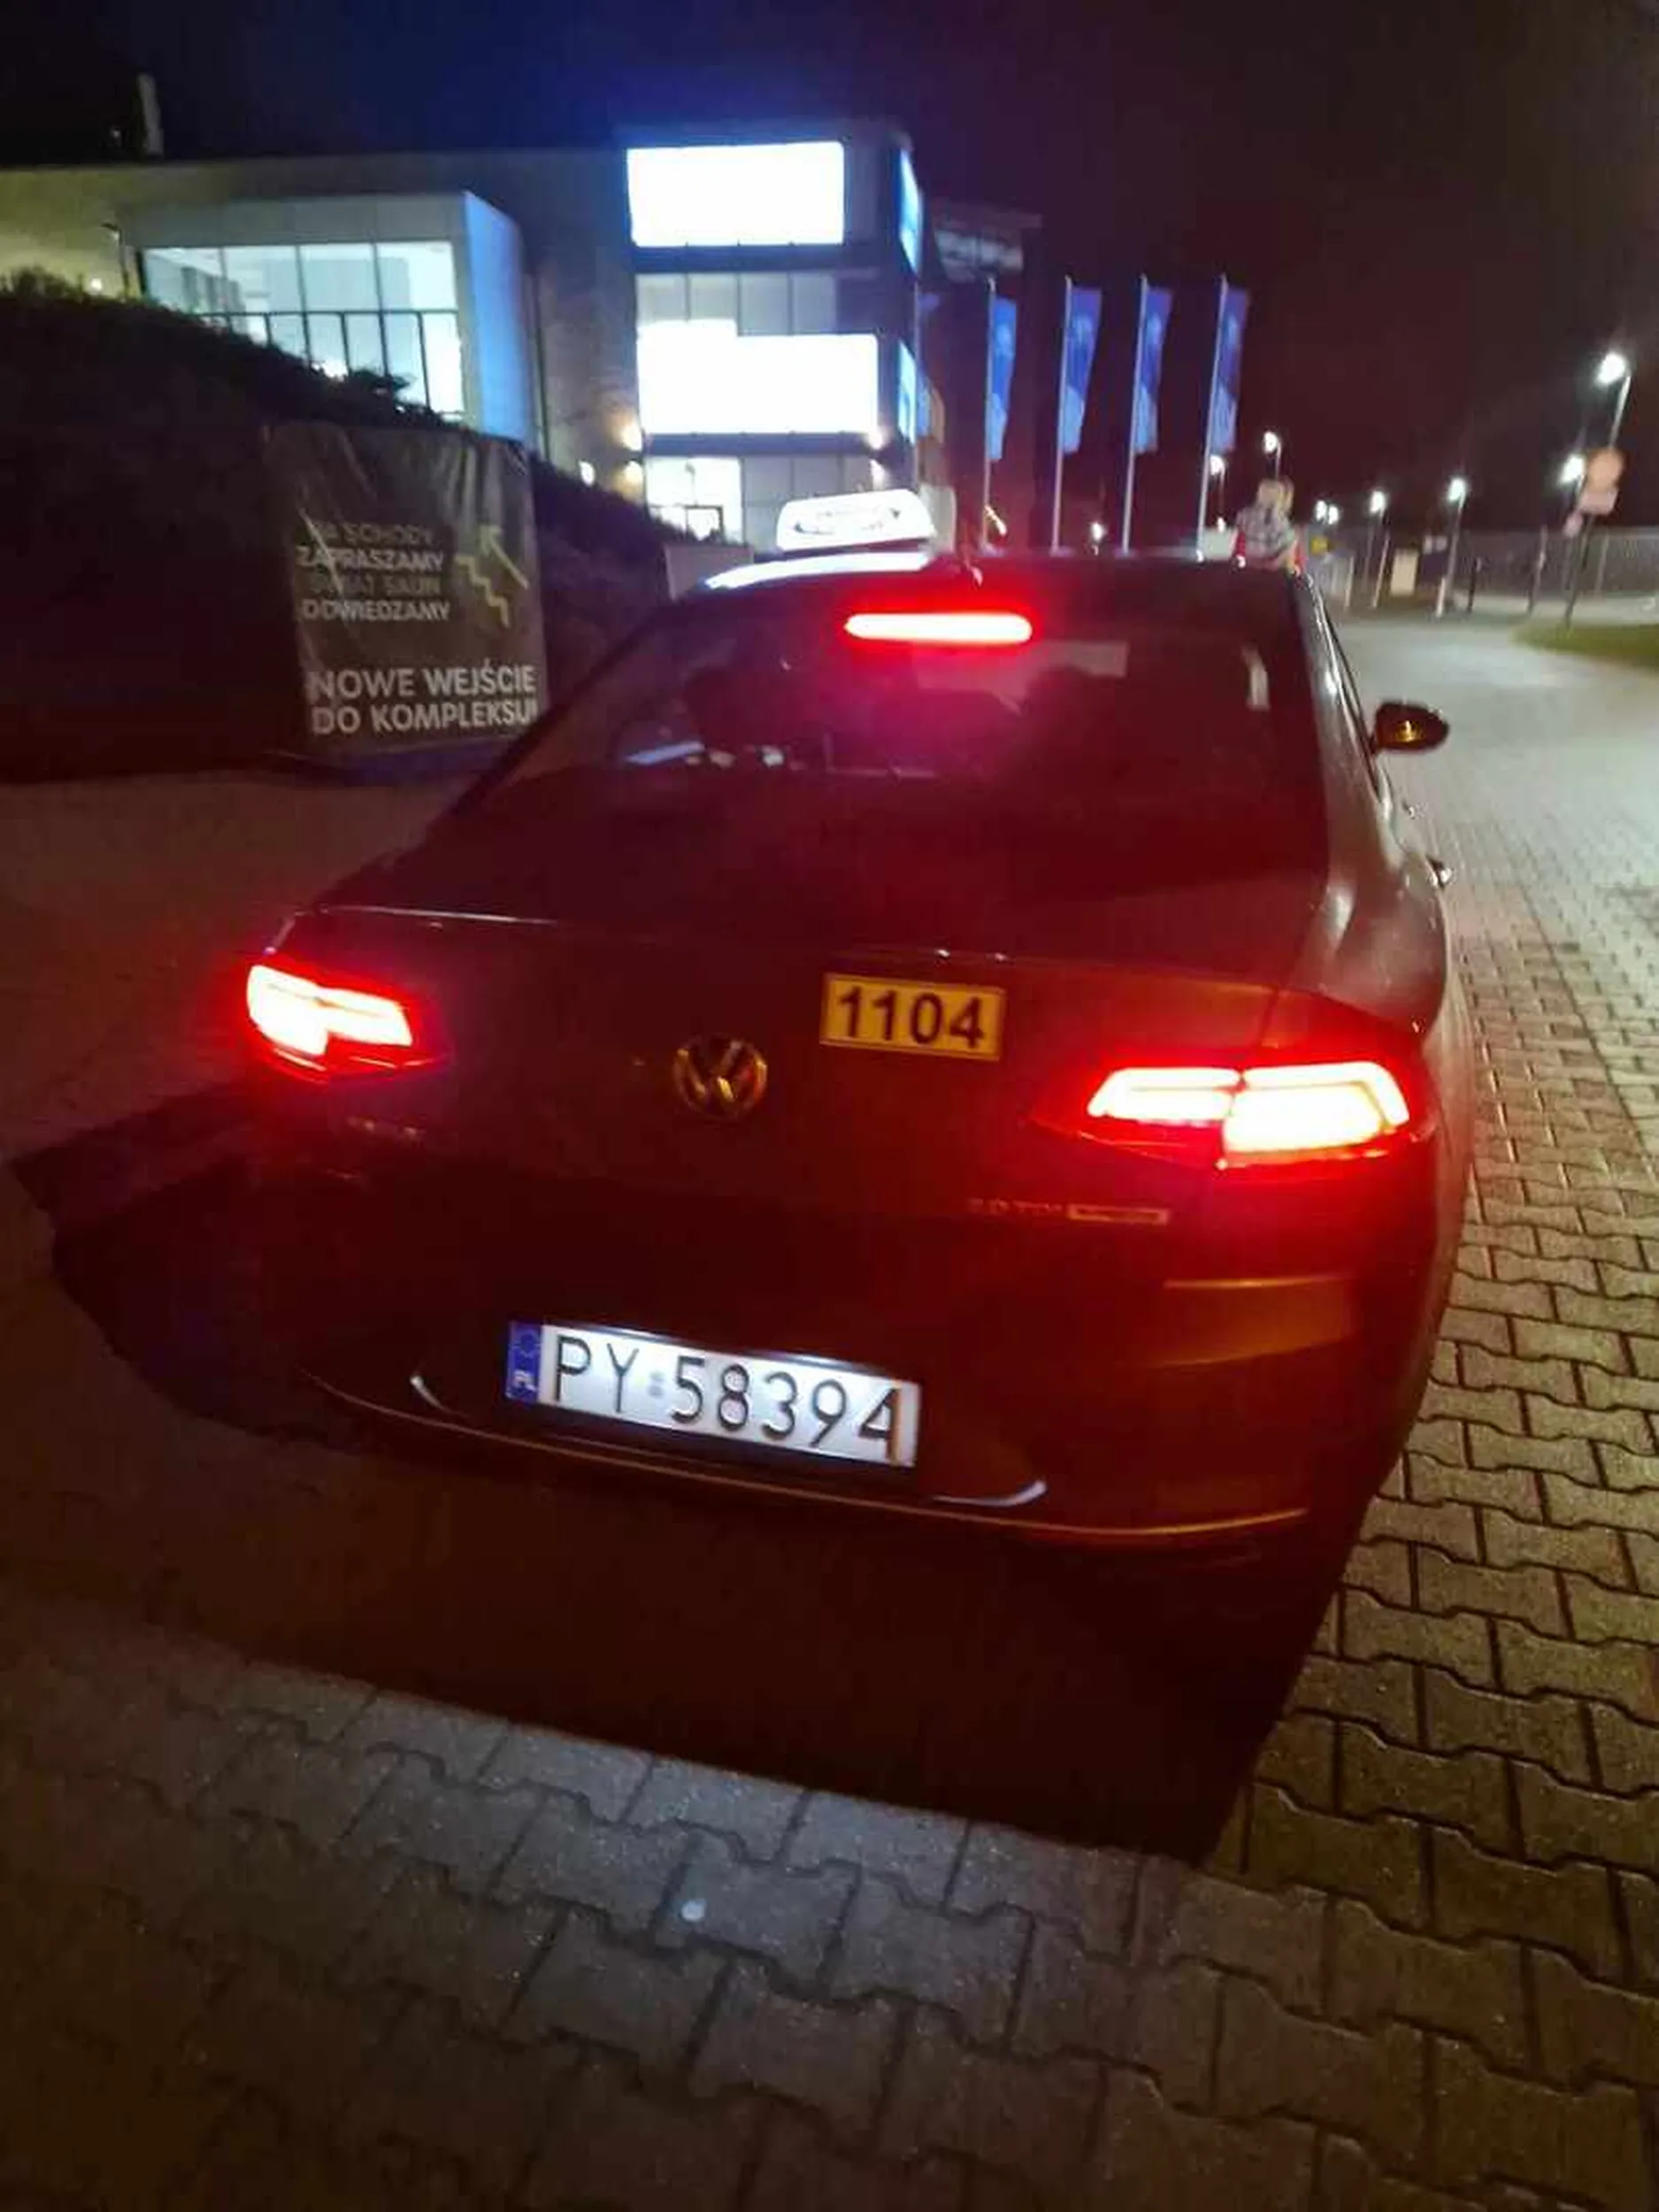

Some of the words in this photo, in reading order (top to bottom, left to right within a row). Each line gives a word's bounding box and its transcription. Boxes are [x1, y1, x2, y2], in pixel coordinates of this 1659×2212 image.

[307, 669, 416, 701] NOWE
[421, 658, 536, 695] WEJŚCIE
[311, 707, 361, 735] DO
[838, 985, 986, 1048] 1104
[555, 1334, 639, 1414] PY
[670, 1355, 903, 1462] 58394
